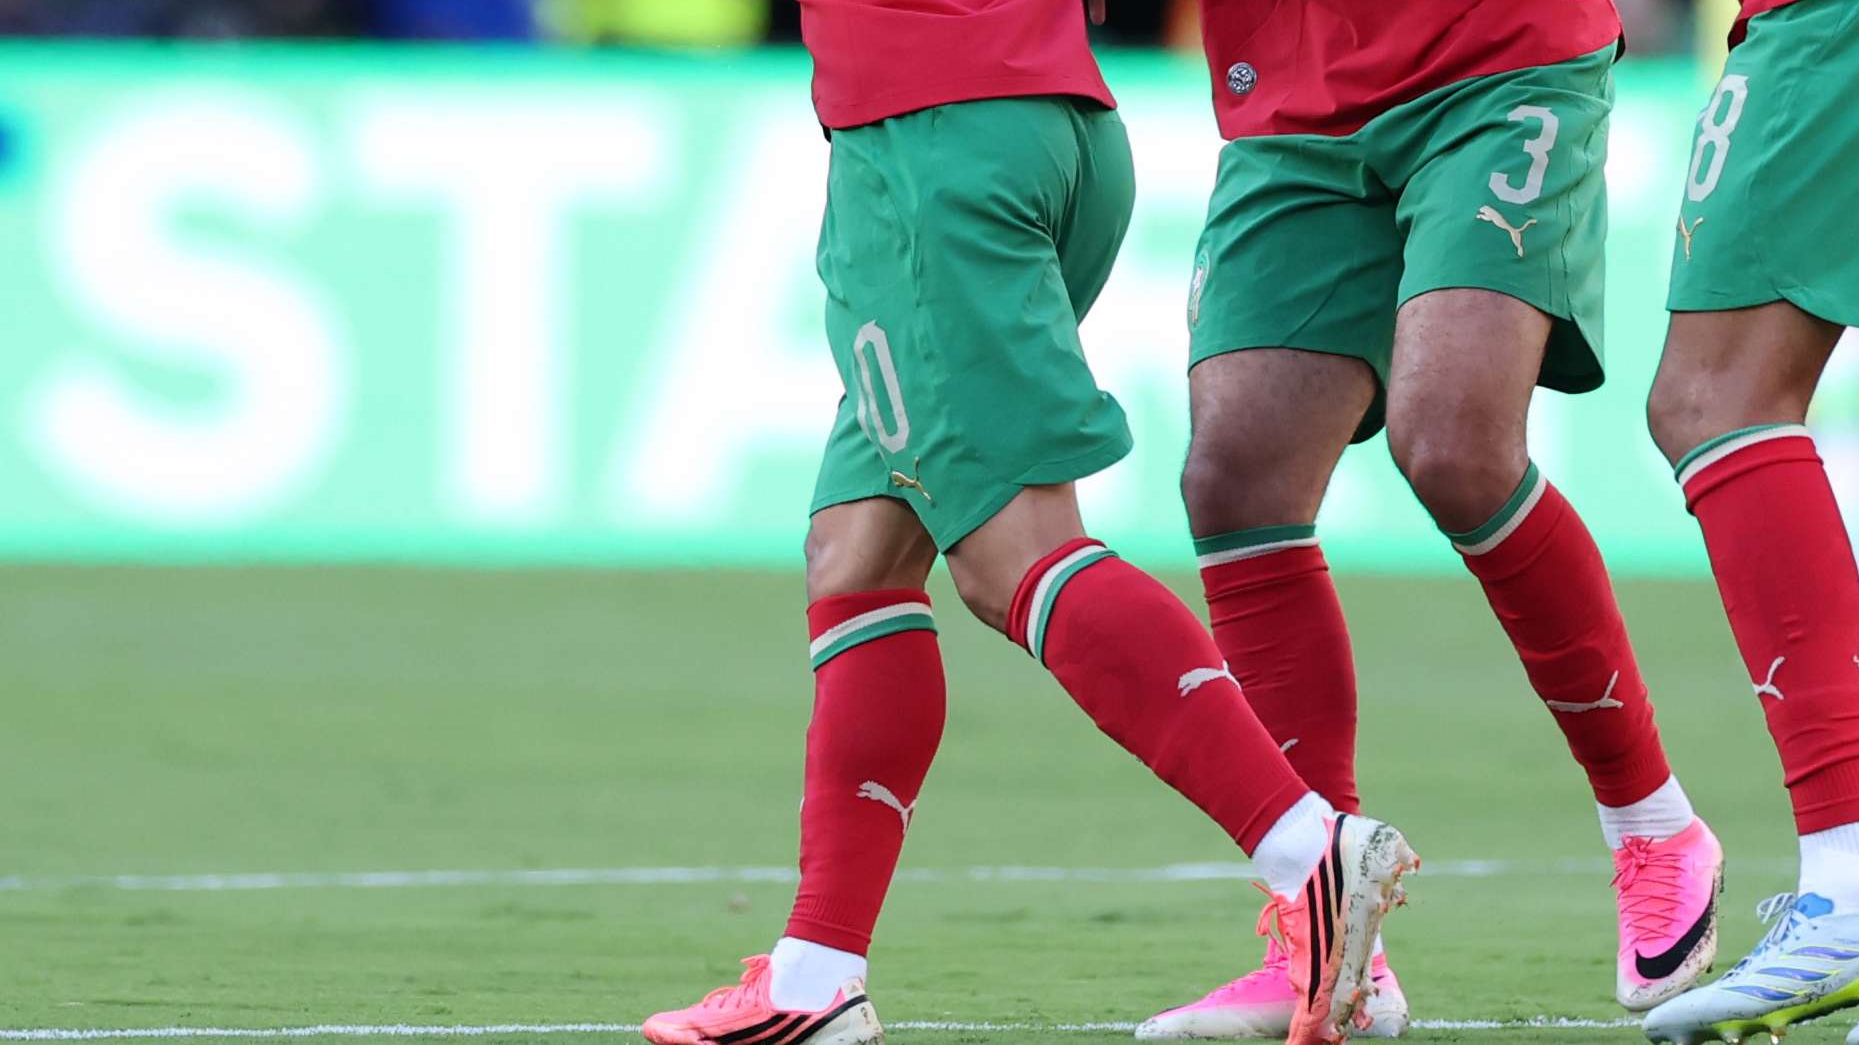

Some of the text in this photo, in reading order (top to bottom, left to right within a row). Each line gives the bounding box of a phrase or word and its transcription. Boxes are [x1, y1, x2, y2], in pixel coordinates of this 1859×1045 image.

[1488, 104, 1559, 205] 3
[1687, 73, 1750, 203] 8
[852, 318, 911, 454] 0
